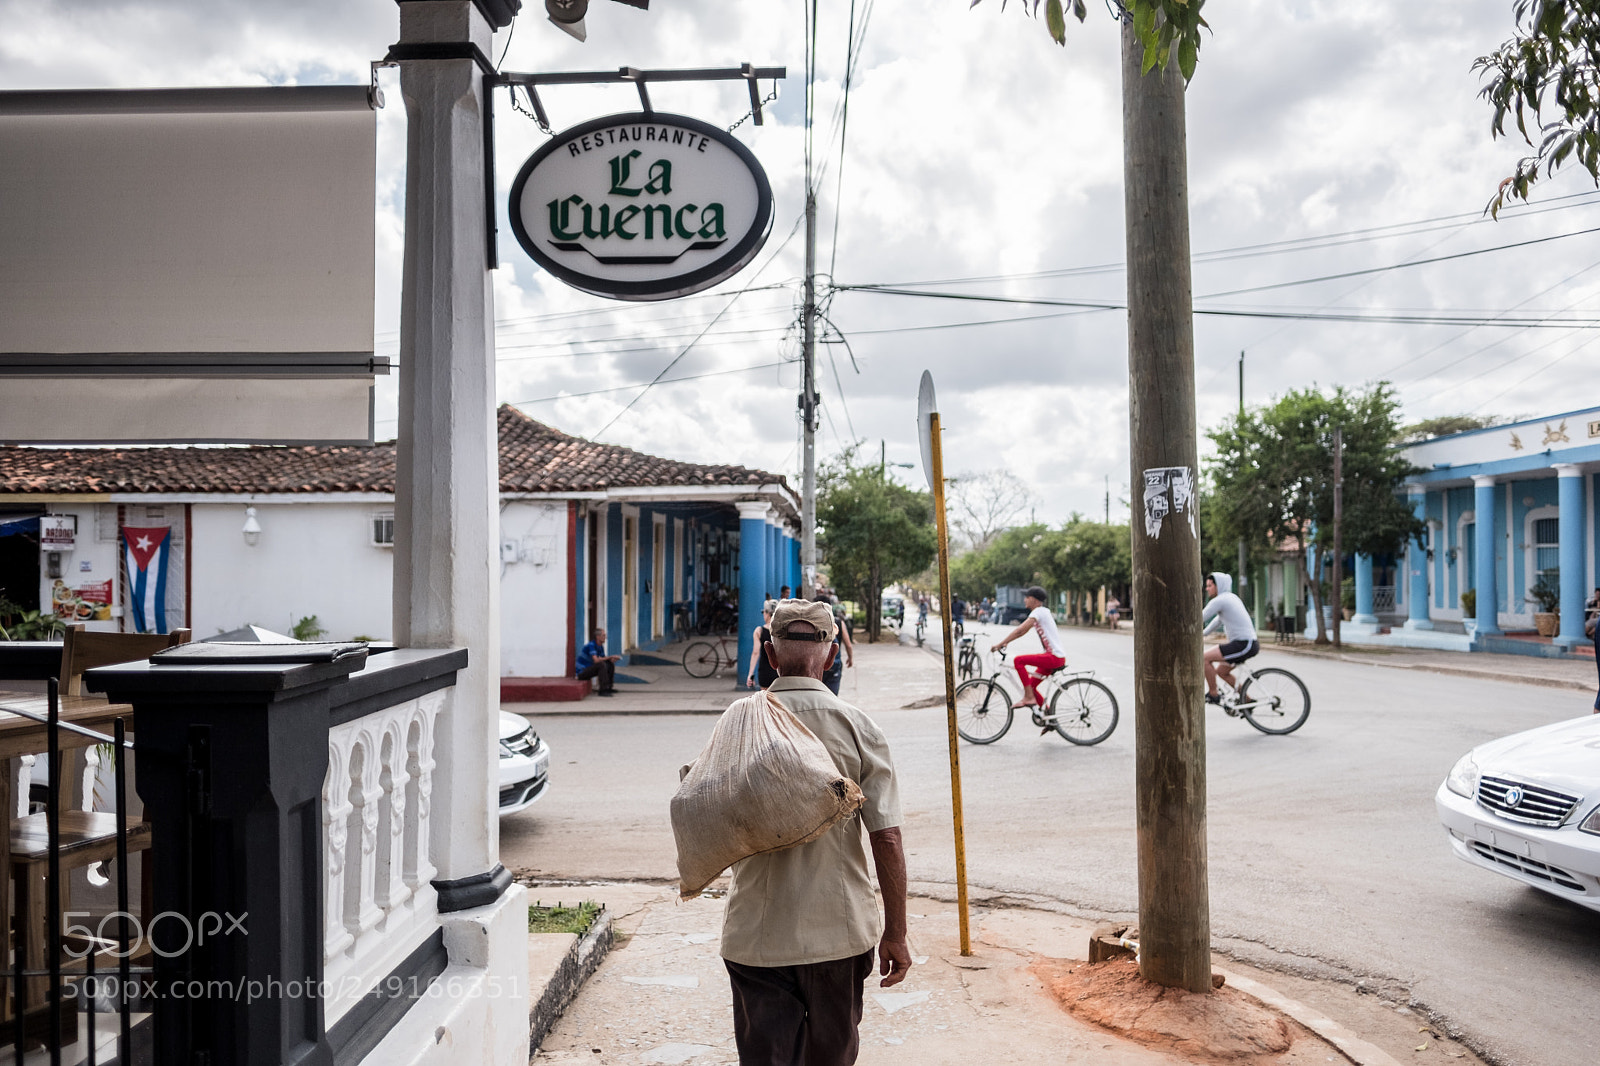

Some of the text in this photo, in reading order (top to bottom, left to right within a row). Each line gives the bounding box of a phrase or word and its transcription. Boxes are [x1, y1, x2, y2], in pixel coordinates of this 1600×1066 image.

[567, 126, 710, 158] RESTAURANTE
[608, 150, 673, 197] La
[546, 194, 727, 241] Cuenca
